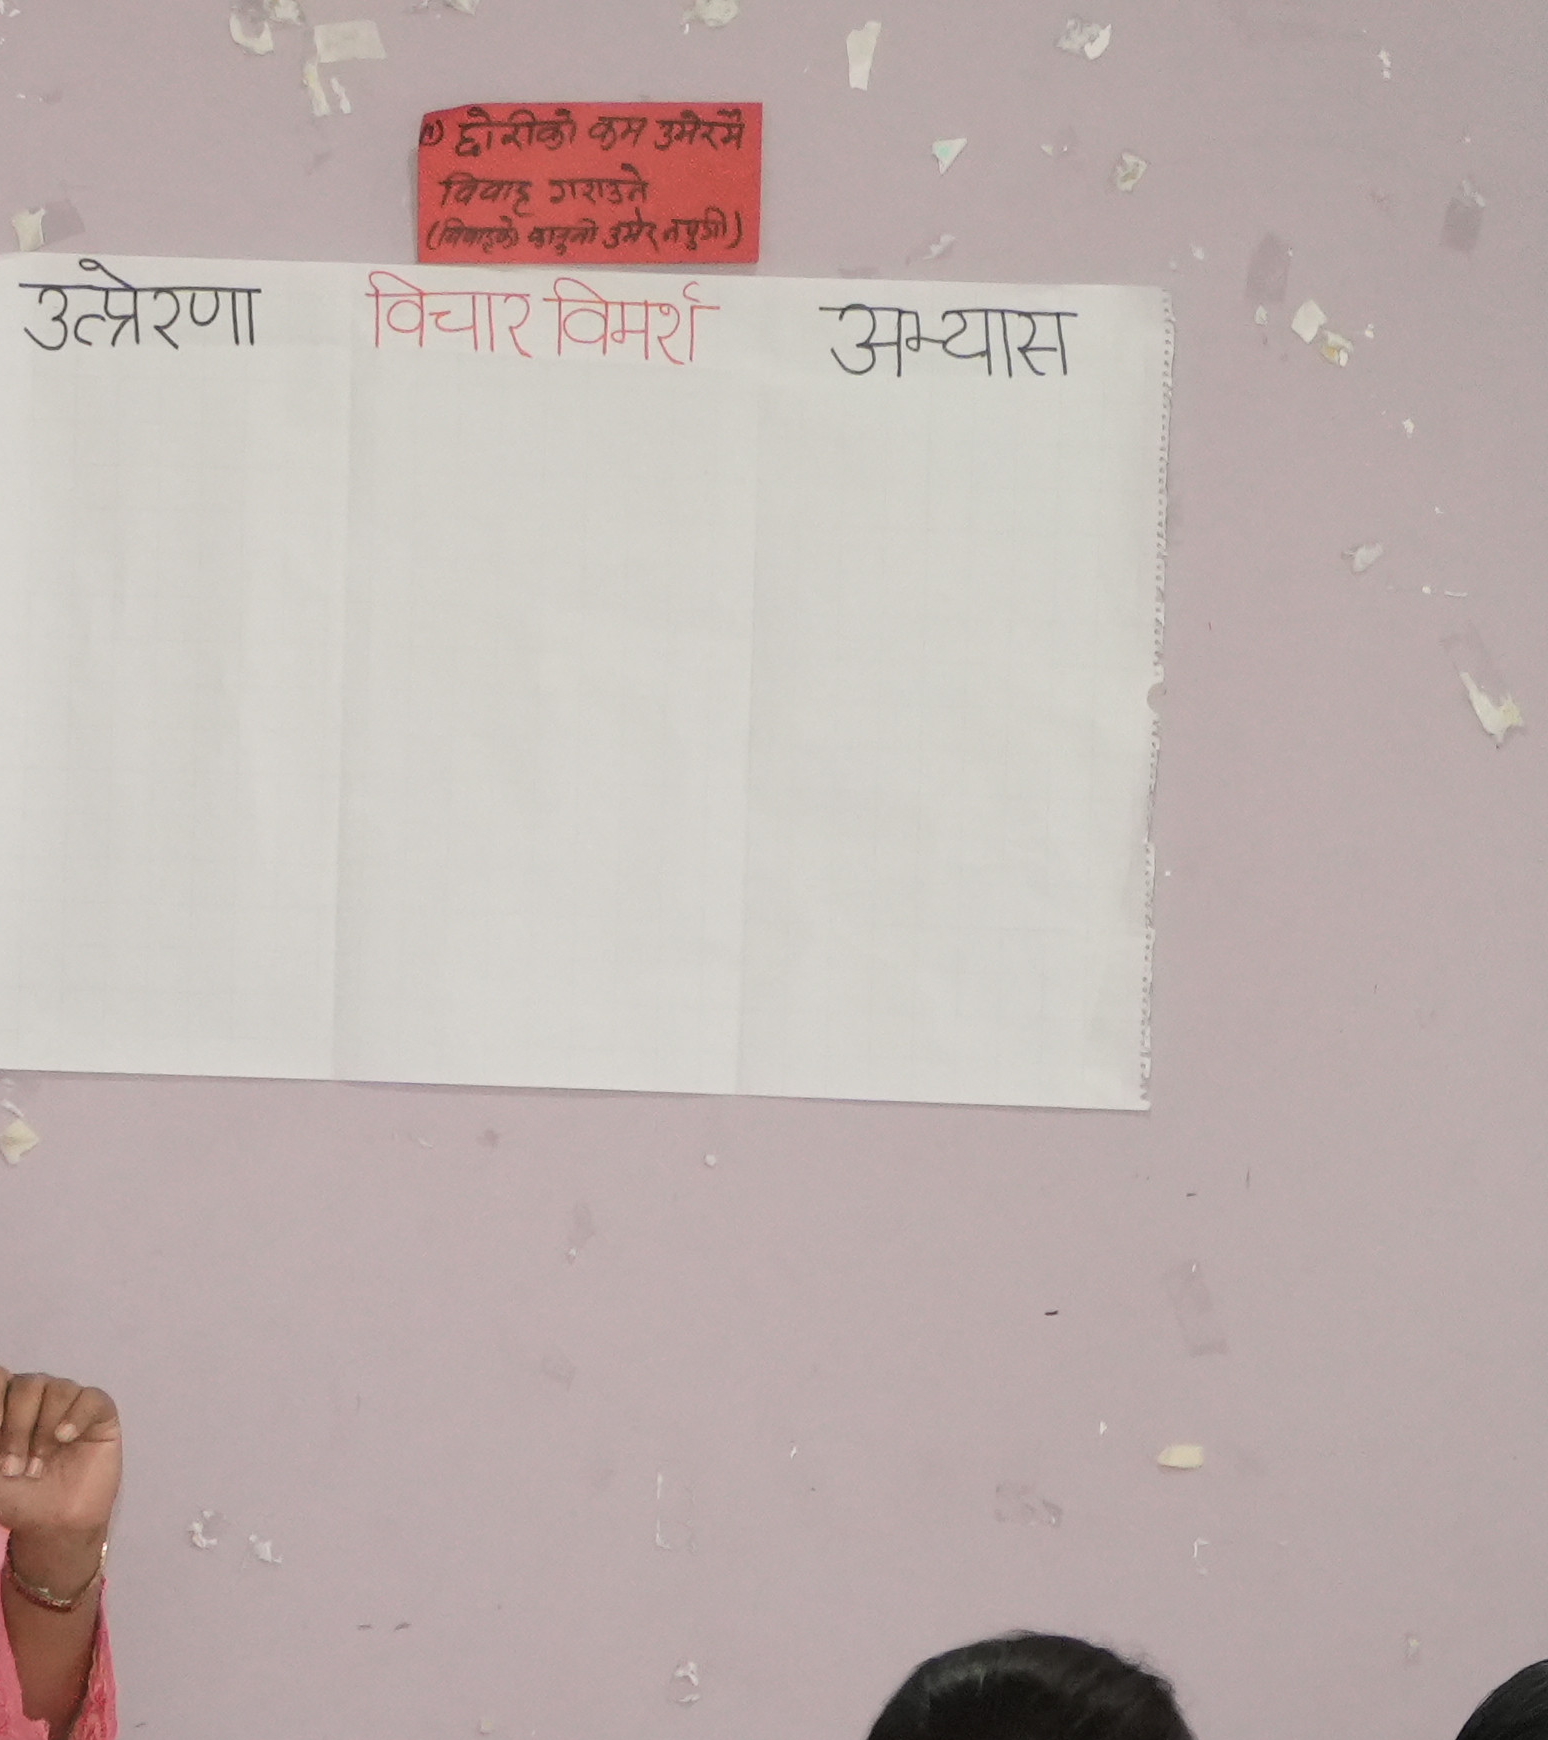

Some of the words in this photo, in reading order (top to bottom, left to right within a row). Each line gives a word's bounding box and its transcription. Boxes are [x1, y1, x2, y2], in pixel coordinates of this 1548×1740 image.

[364, 270, 534, 358] विचार
[542, 277, 720, 366] विमर्श
[818, 299, 1079, 378] अभ्यास
